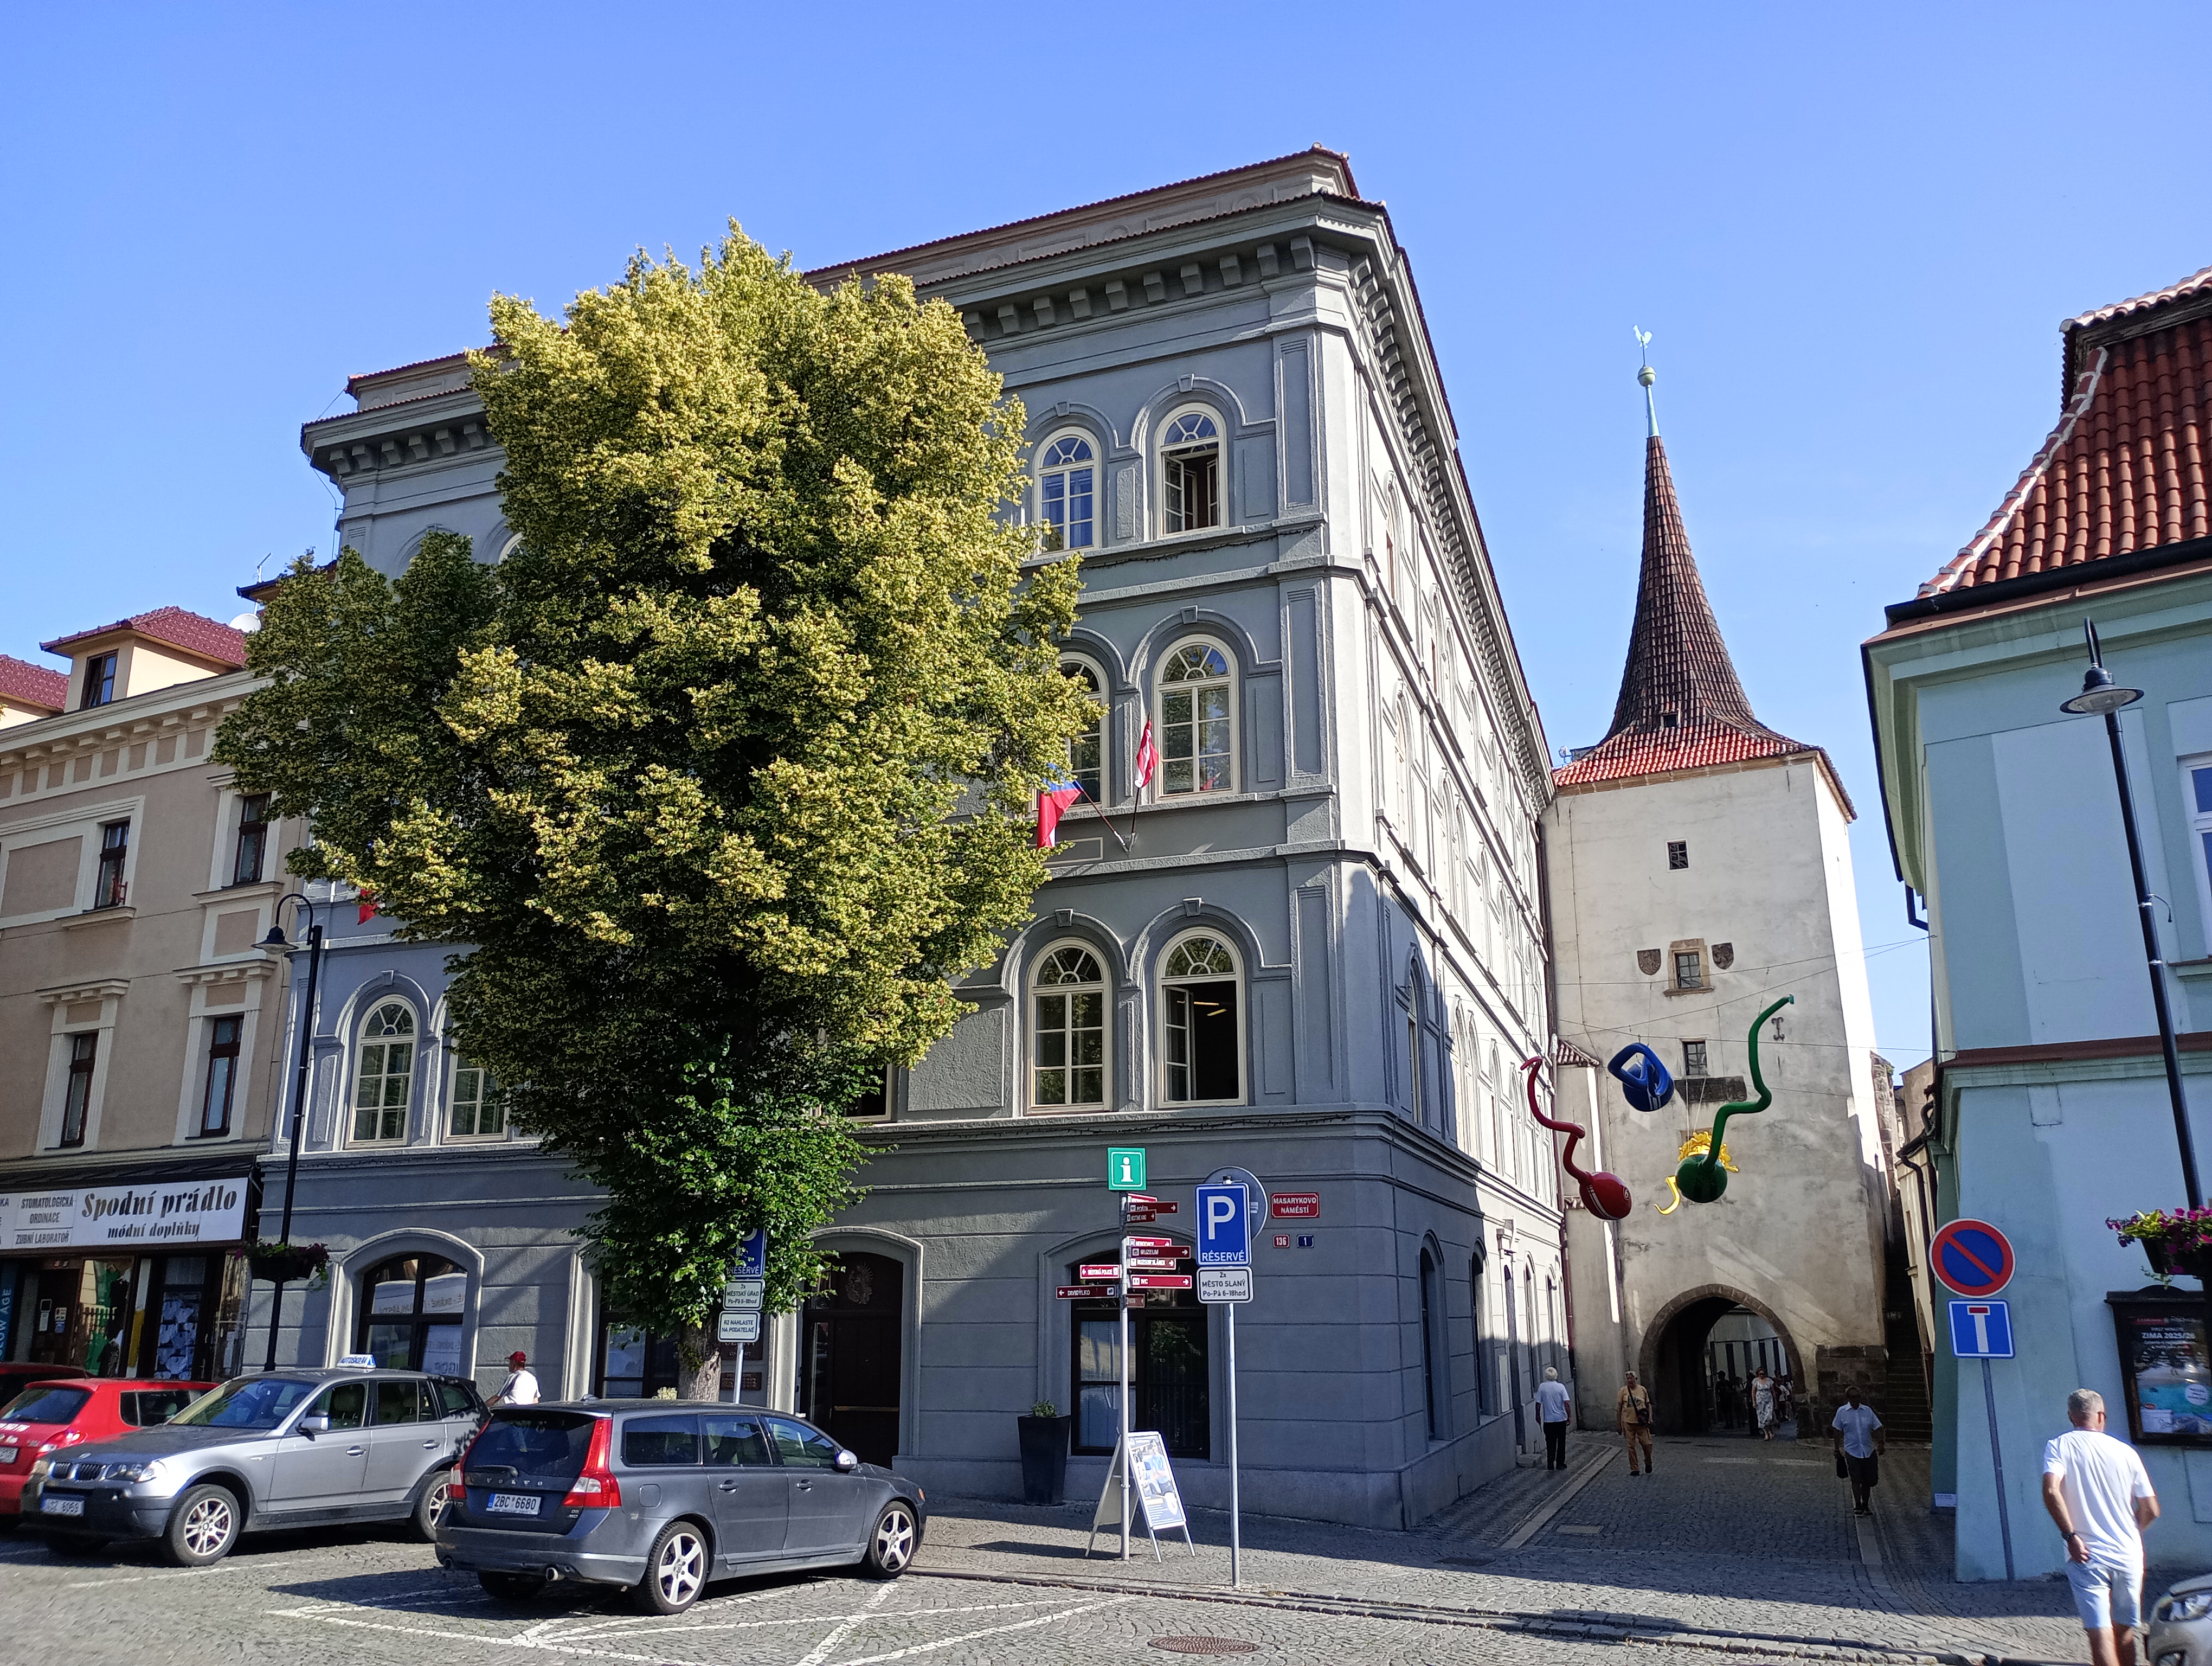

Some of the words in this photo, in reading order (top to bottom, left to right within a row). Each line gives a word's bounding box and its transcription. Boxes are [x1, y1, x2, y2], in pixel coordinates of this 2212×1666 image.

[21, 1194, 74, 1209] STOMATOLOGICKÁ
[82, 1190, 157, 1221] Spodní
[160, 1185, 237, 1218] prádlo
[1281, 1205, 1309, 1214] NÁMĚSTÍ
[30, 1212, 60, 1224] ORDINACE
[1207, 1196, 1236, 1240] P
[107, 1223, 146, 1239] módní
[149, 1221, 200, 1239] doplňky
[15, 1232, 34, 1245] ZUBNÍ
[35, 1230, 69, 1244] LABORATOŘ
[1276, 1237, 1287, 1246] 136
[1303, 1237, 1307, 1246] 1
[1201, 1250, 1245, 1261] RÉSERVÉ
[1202, 1280, 1224, 1288] MĚSTO
[1225, 1279, 1246, 1287] SLANÝ
[486, 1478, 544, 1486] VOLVO
[494, 1495, 511, 1508] 2BC
[515, 1498, 537, 1510] 6680
